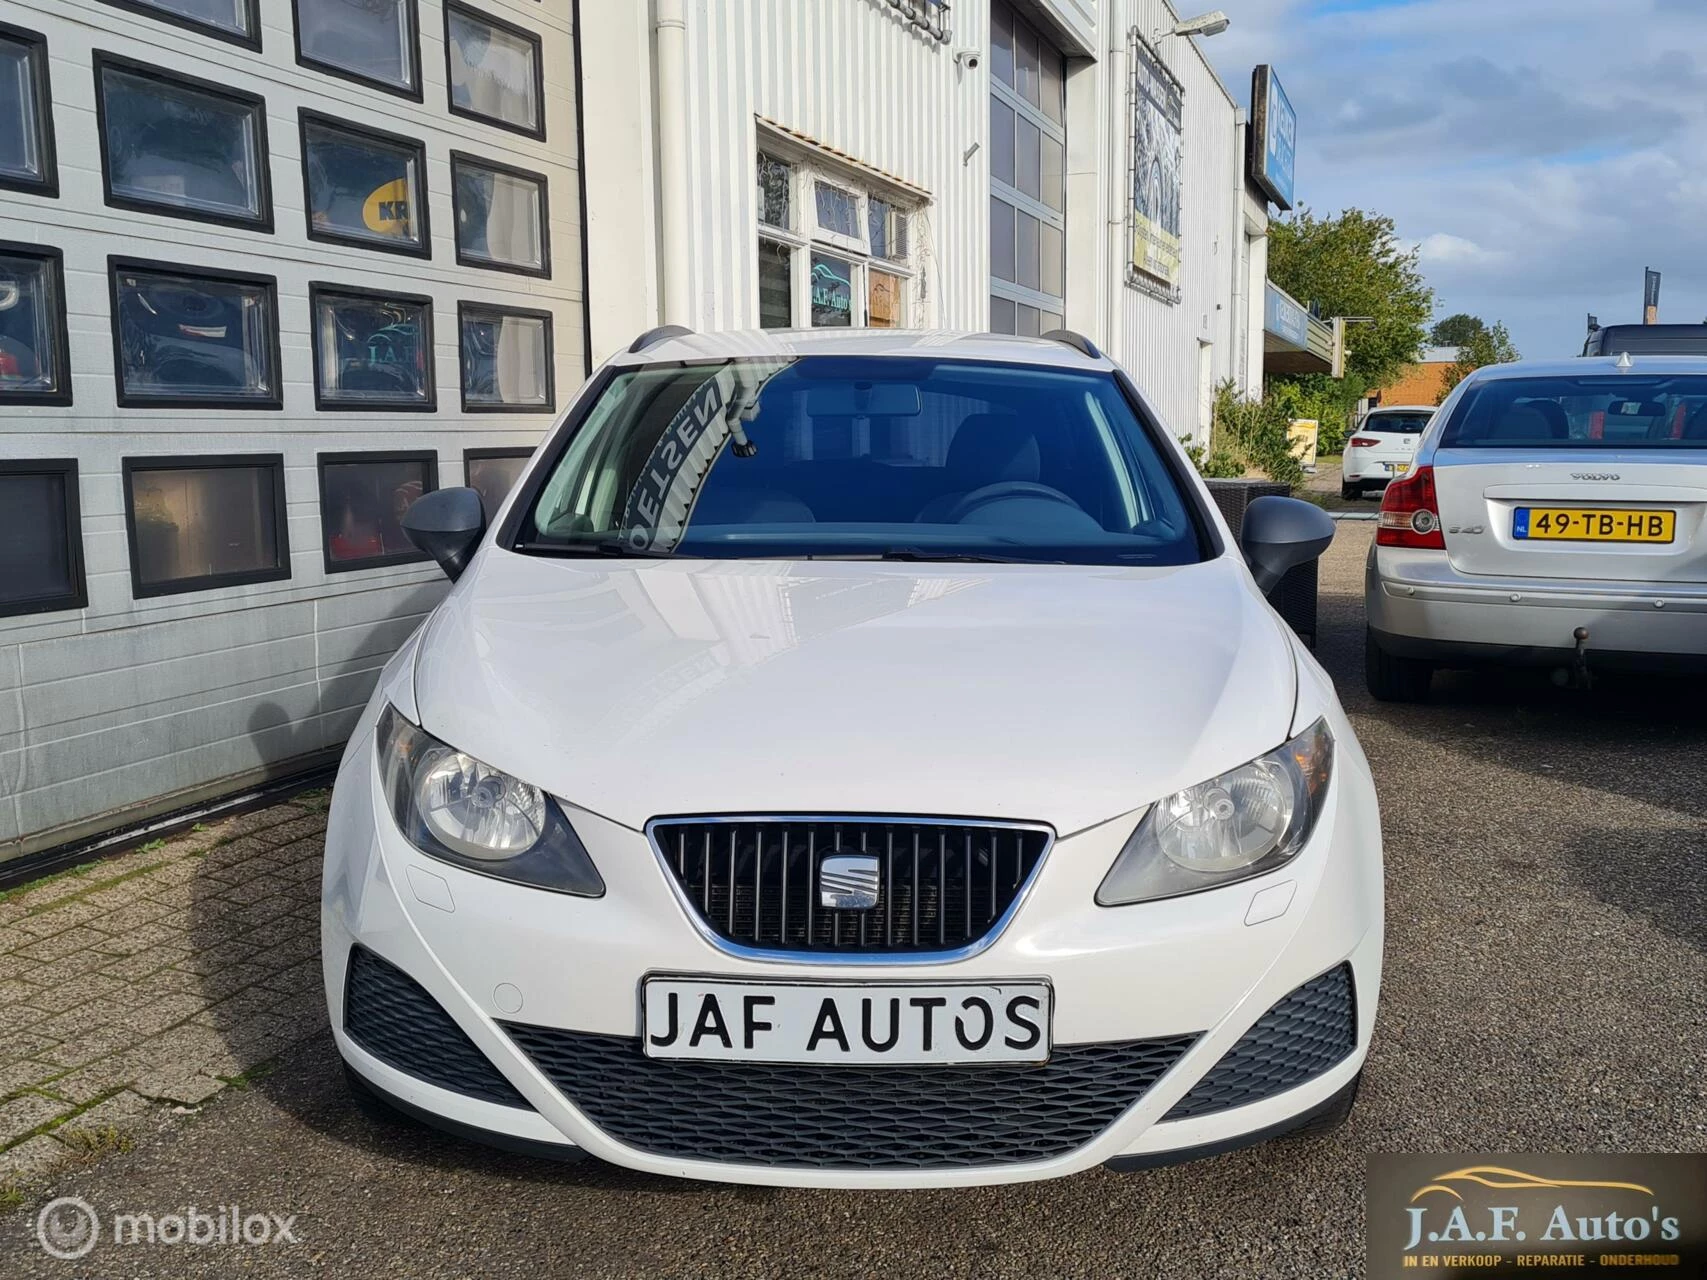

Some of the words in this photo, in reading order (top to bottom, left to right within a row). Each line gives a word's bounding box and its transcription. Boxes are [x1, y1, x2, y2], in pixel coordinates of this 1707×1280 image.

[1570, 472, 1621, 481] VOLVO
[1535, 513, 1664, 537] 49-TB-HB
[650, 992, 776, 1049] JAF
[806, 995, 1041, 1052] AUTOS
